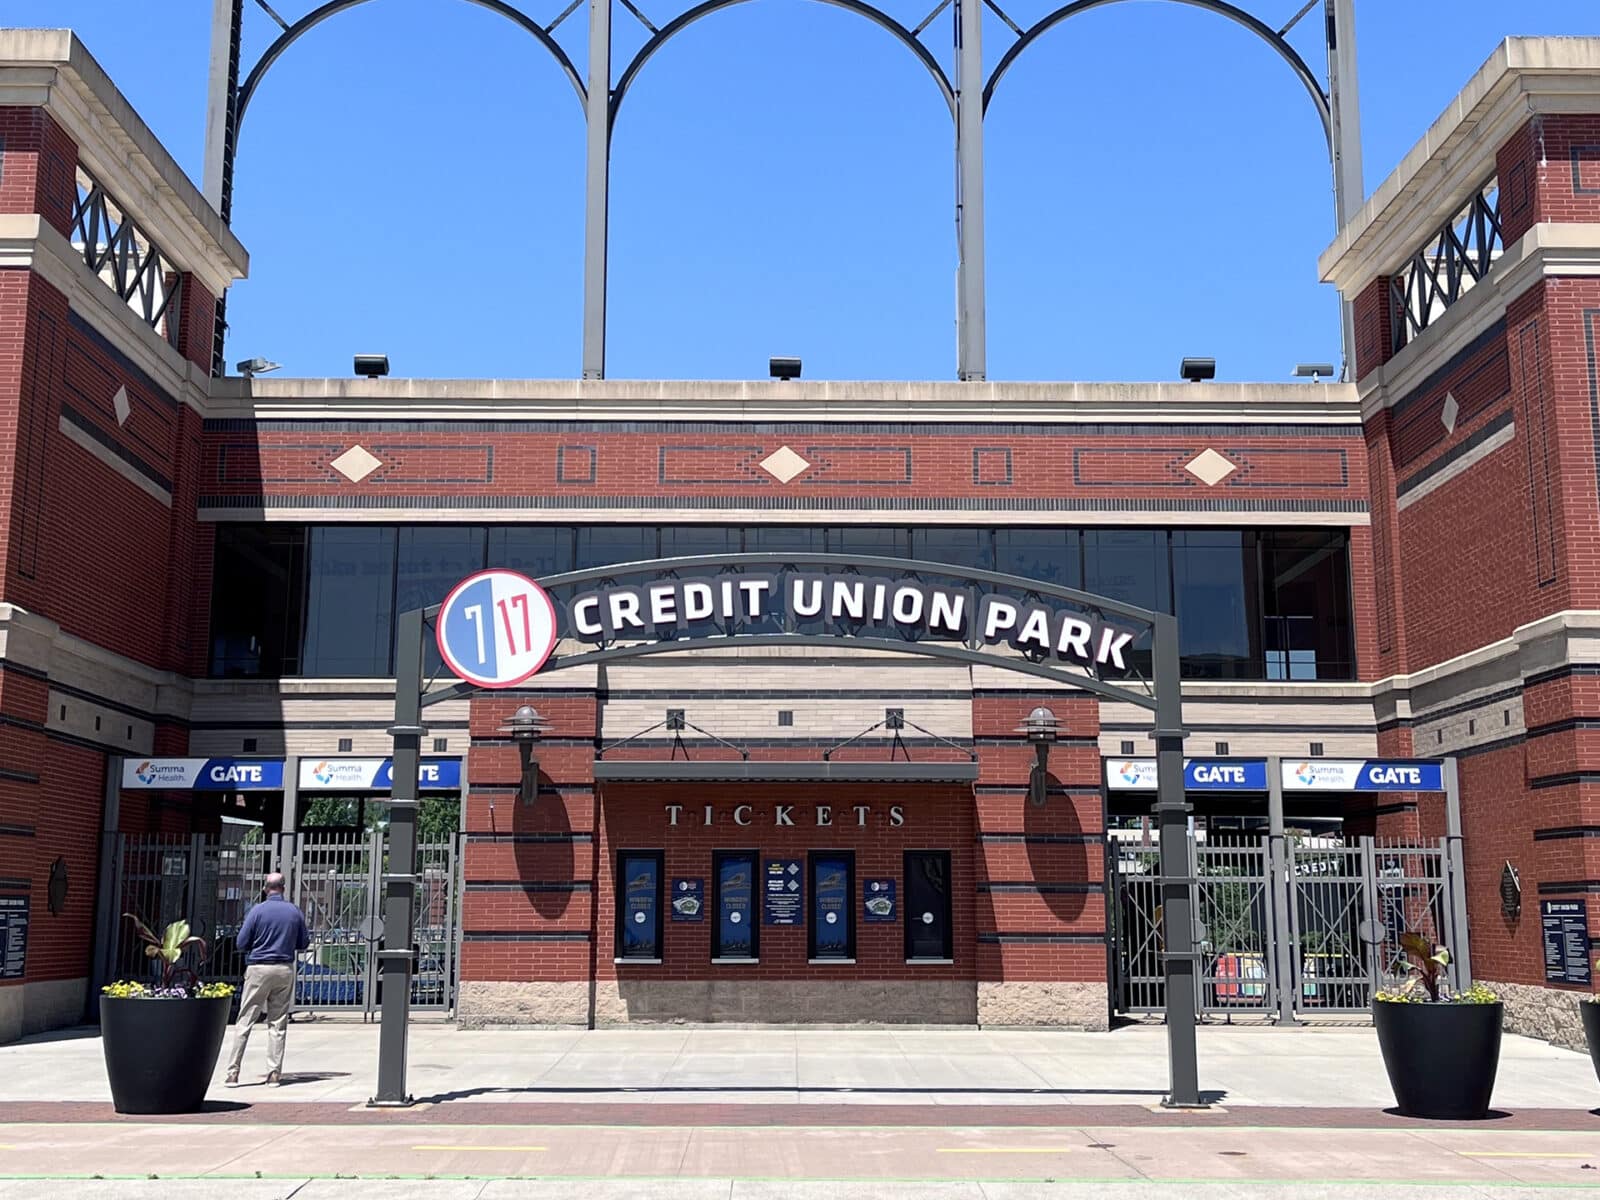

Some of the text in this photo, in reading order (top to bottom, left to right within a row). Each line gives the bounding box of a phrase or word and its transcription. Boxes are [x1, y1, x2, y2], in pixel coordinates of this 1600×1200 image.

[574, 580, 769, 636] CREDIT
[793, 580, 965, 632] UNION
[984, 600, 1135, 670] PARK
[150, 765, 185, 773] Summa
[210, 765, 263, 782] GATE
[327, 764, 362, 773] Summa
[1193, 766, 1245, 783] GATE
[1308, 765, 1344, 774] Summa
[1369, 767, 1421, 784] GATE
[665, 804, 905, 827] TICKETS
[1294, 860, 1339, 876] CREDIT
